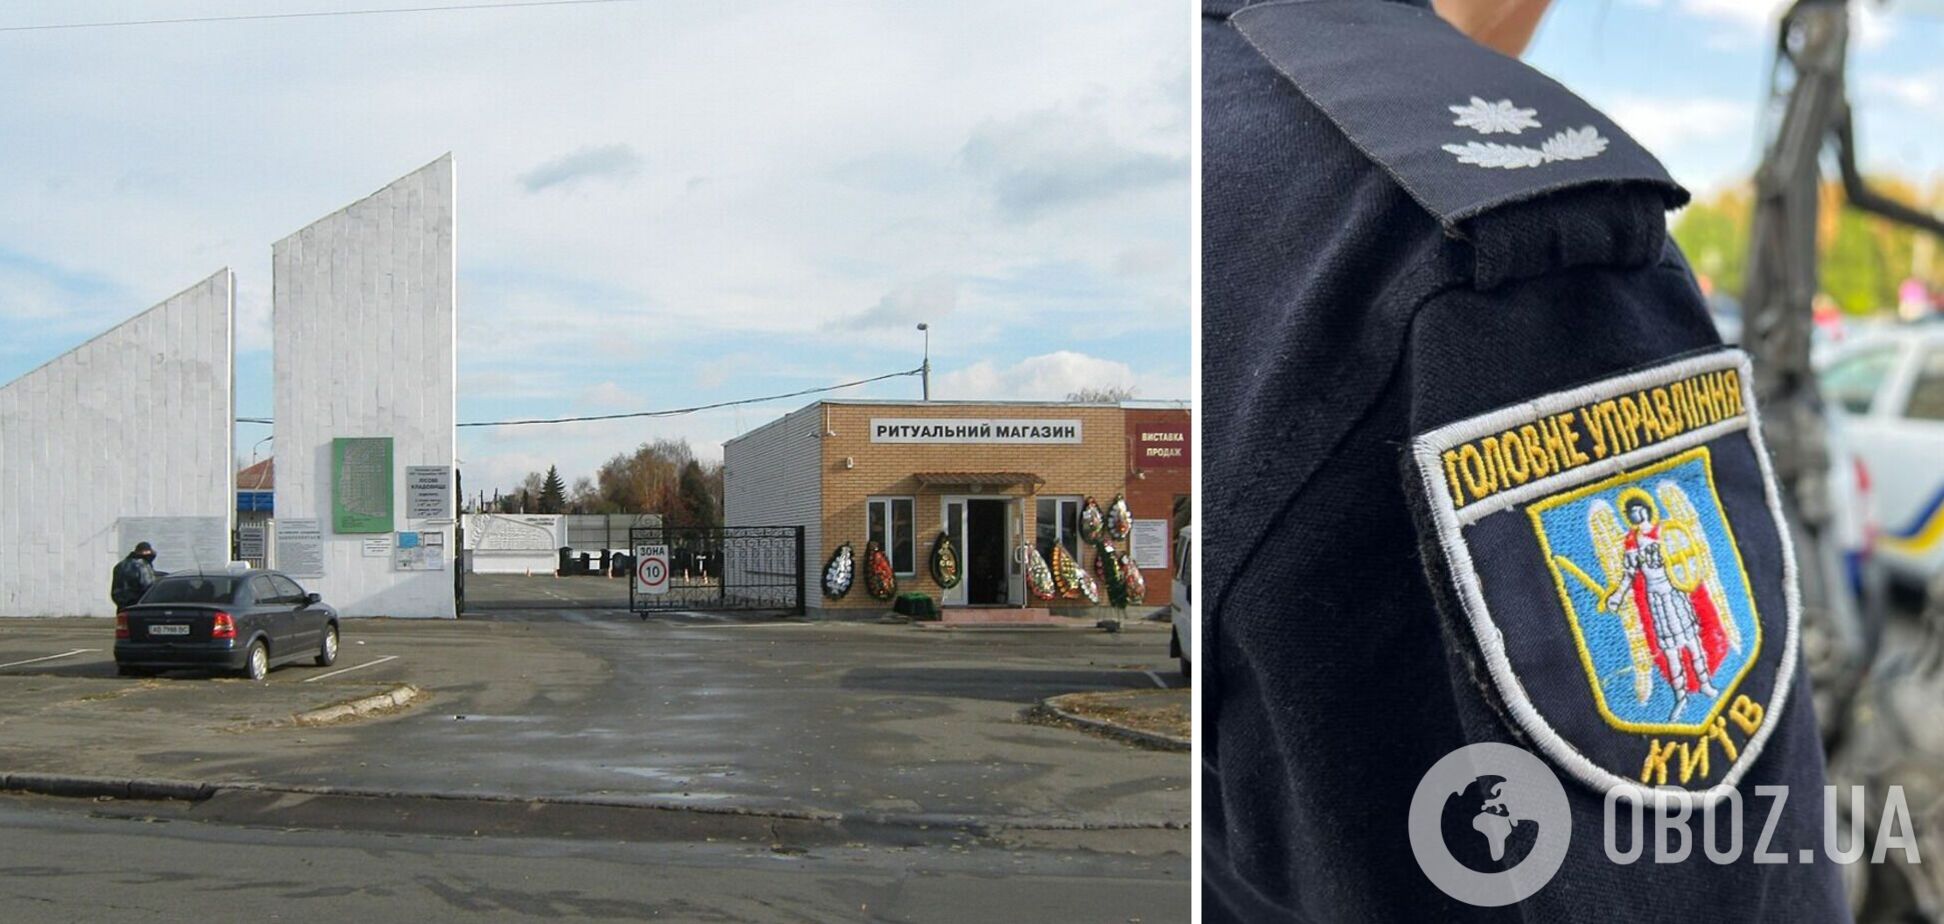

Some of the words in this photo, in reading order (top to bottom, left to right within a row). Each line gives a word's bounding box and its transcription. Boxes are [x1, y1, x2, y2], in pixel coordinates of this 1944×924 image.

[876, 423, 991, 438] РИТУАЛЬНИЙ
[995, 425, 1076, 438] МАГАЗИН
[1141, 432, 1185, 442] ВИСТАВКА
[1442, 411, 1590, 508] ГОЛОВНЕ
[1580, 367, 1746, 460] УПРАВЛІННЯ
[1146, 447, 1183, 458] ПРОДАЖ
[639, 546, 666, 557] ЗОНА
[645, 565, 661, 578] 10
[1640, 694, 1765, 786] КИЇВ
